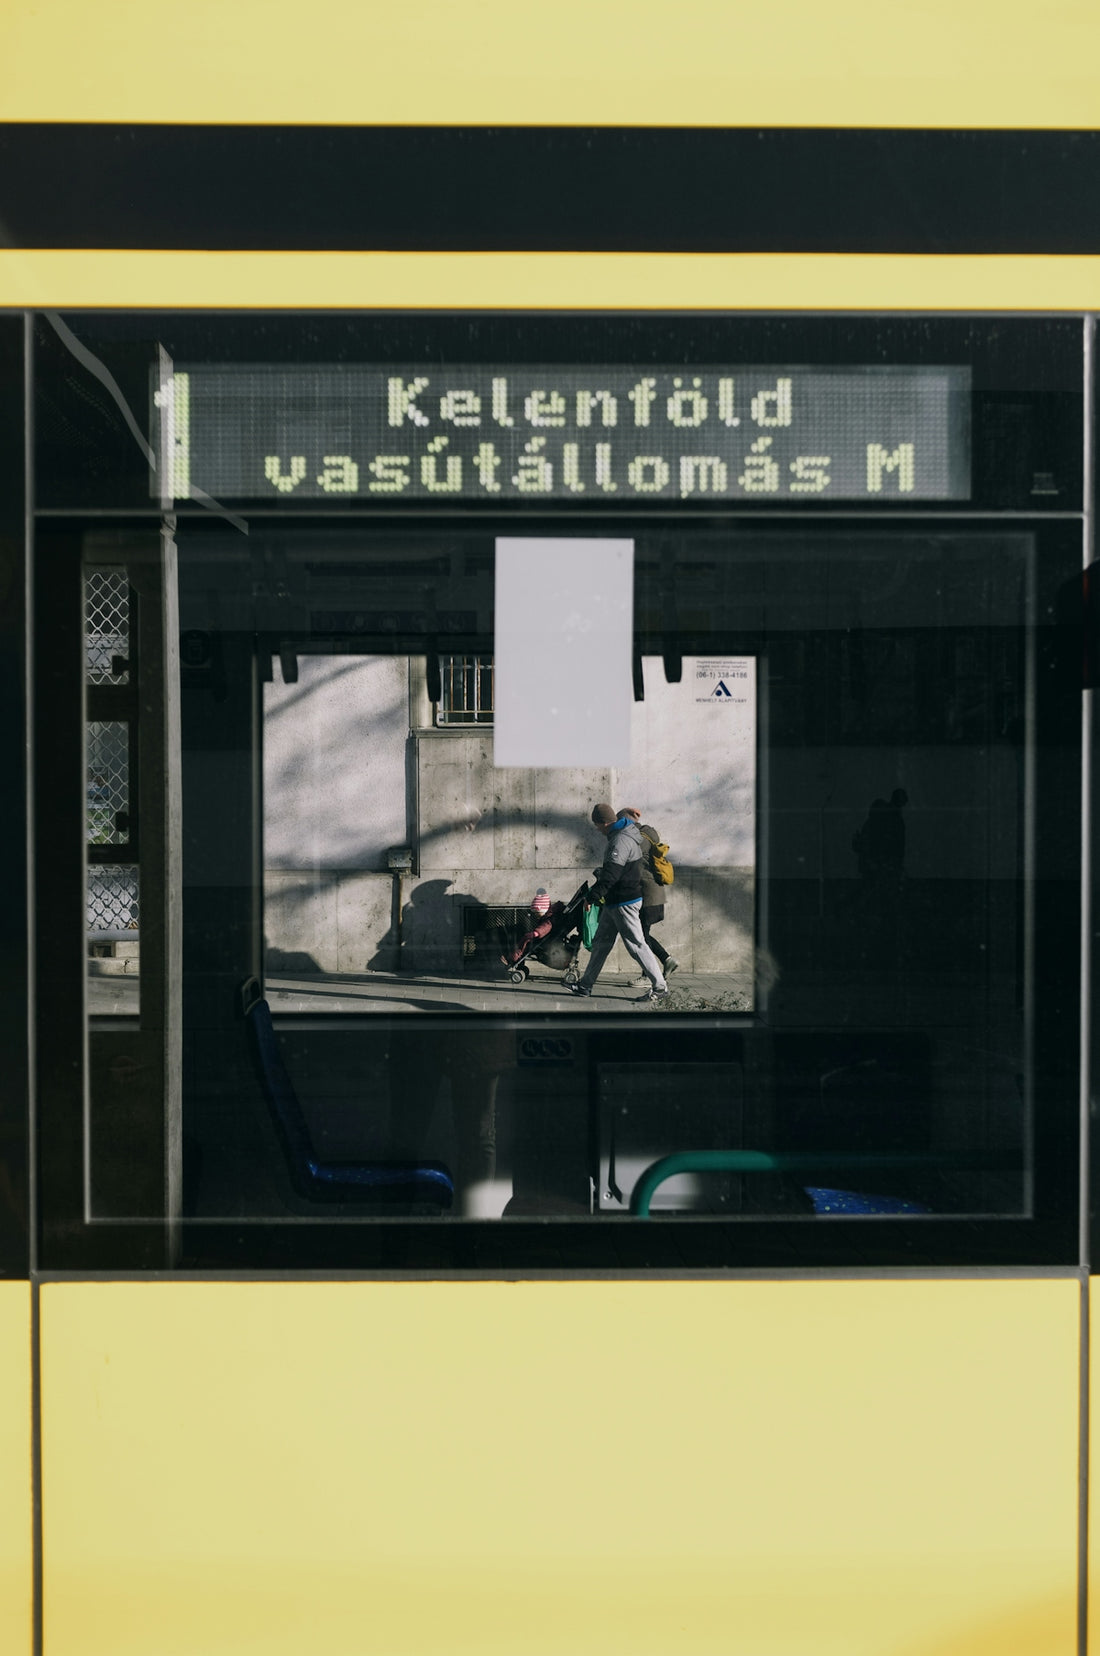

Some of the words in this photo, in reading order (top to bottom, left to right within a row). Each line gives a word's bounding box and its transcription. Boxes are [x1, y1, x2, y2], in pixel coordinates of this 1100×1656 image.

[387, 376, 793, 428] Kelenföld
[264, 436, 831, 494] vasútállomás
[866, 443, 915, 493] M
